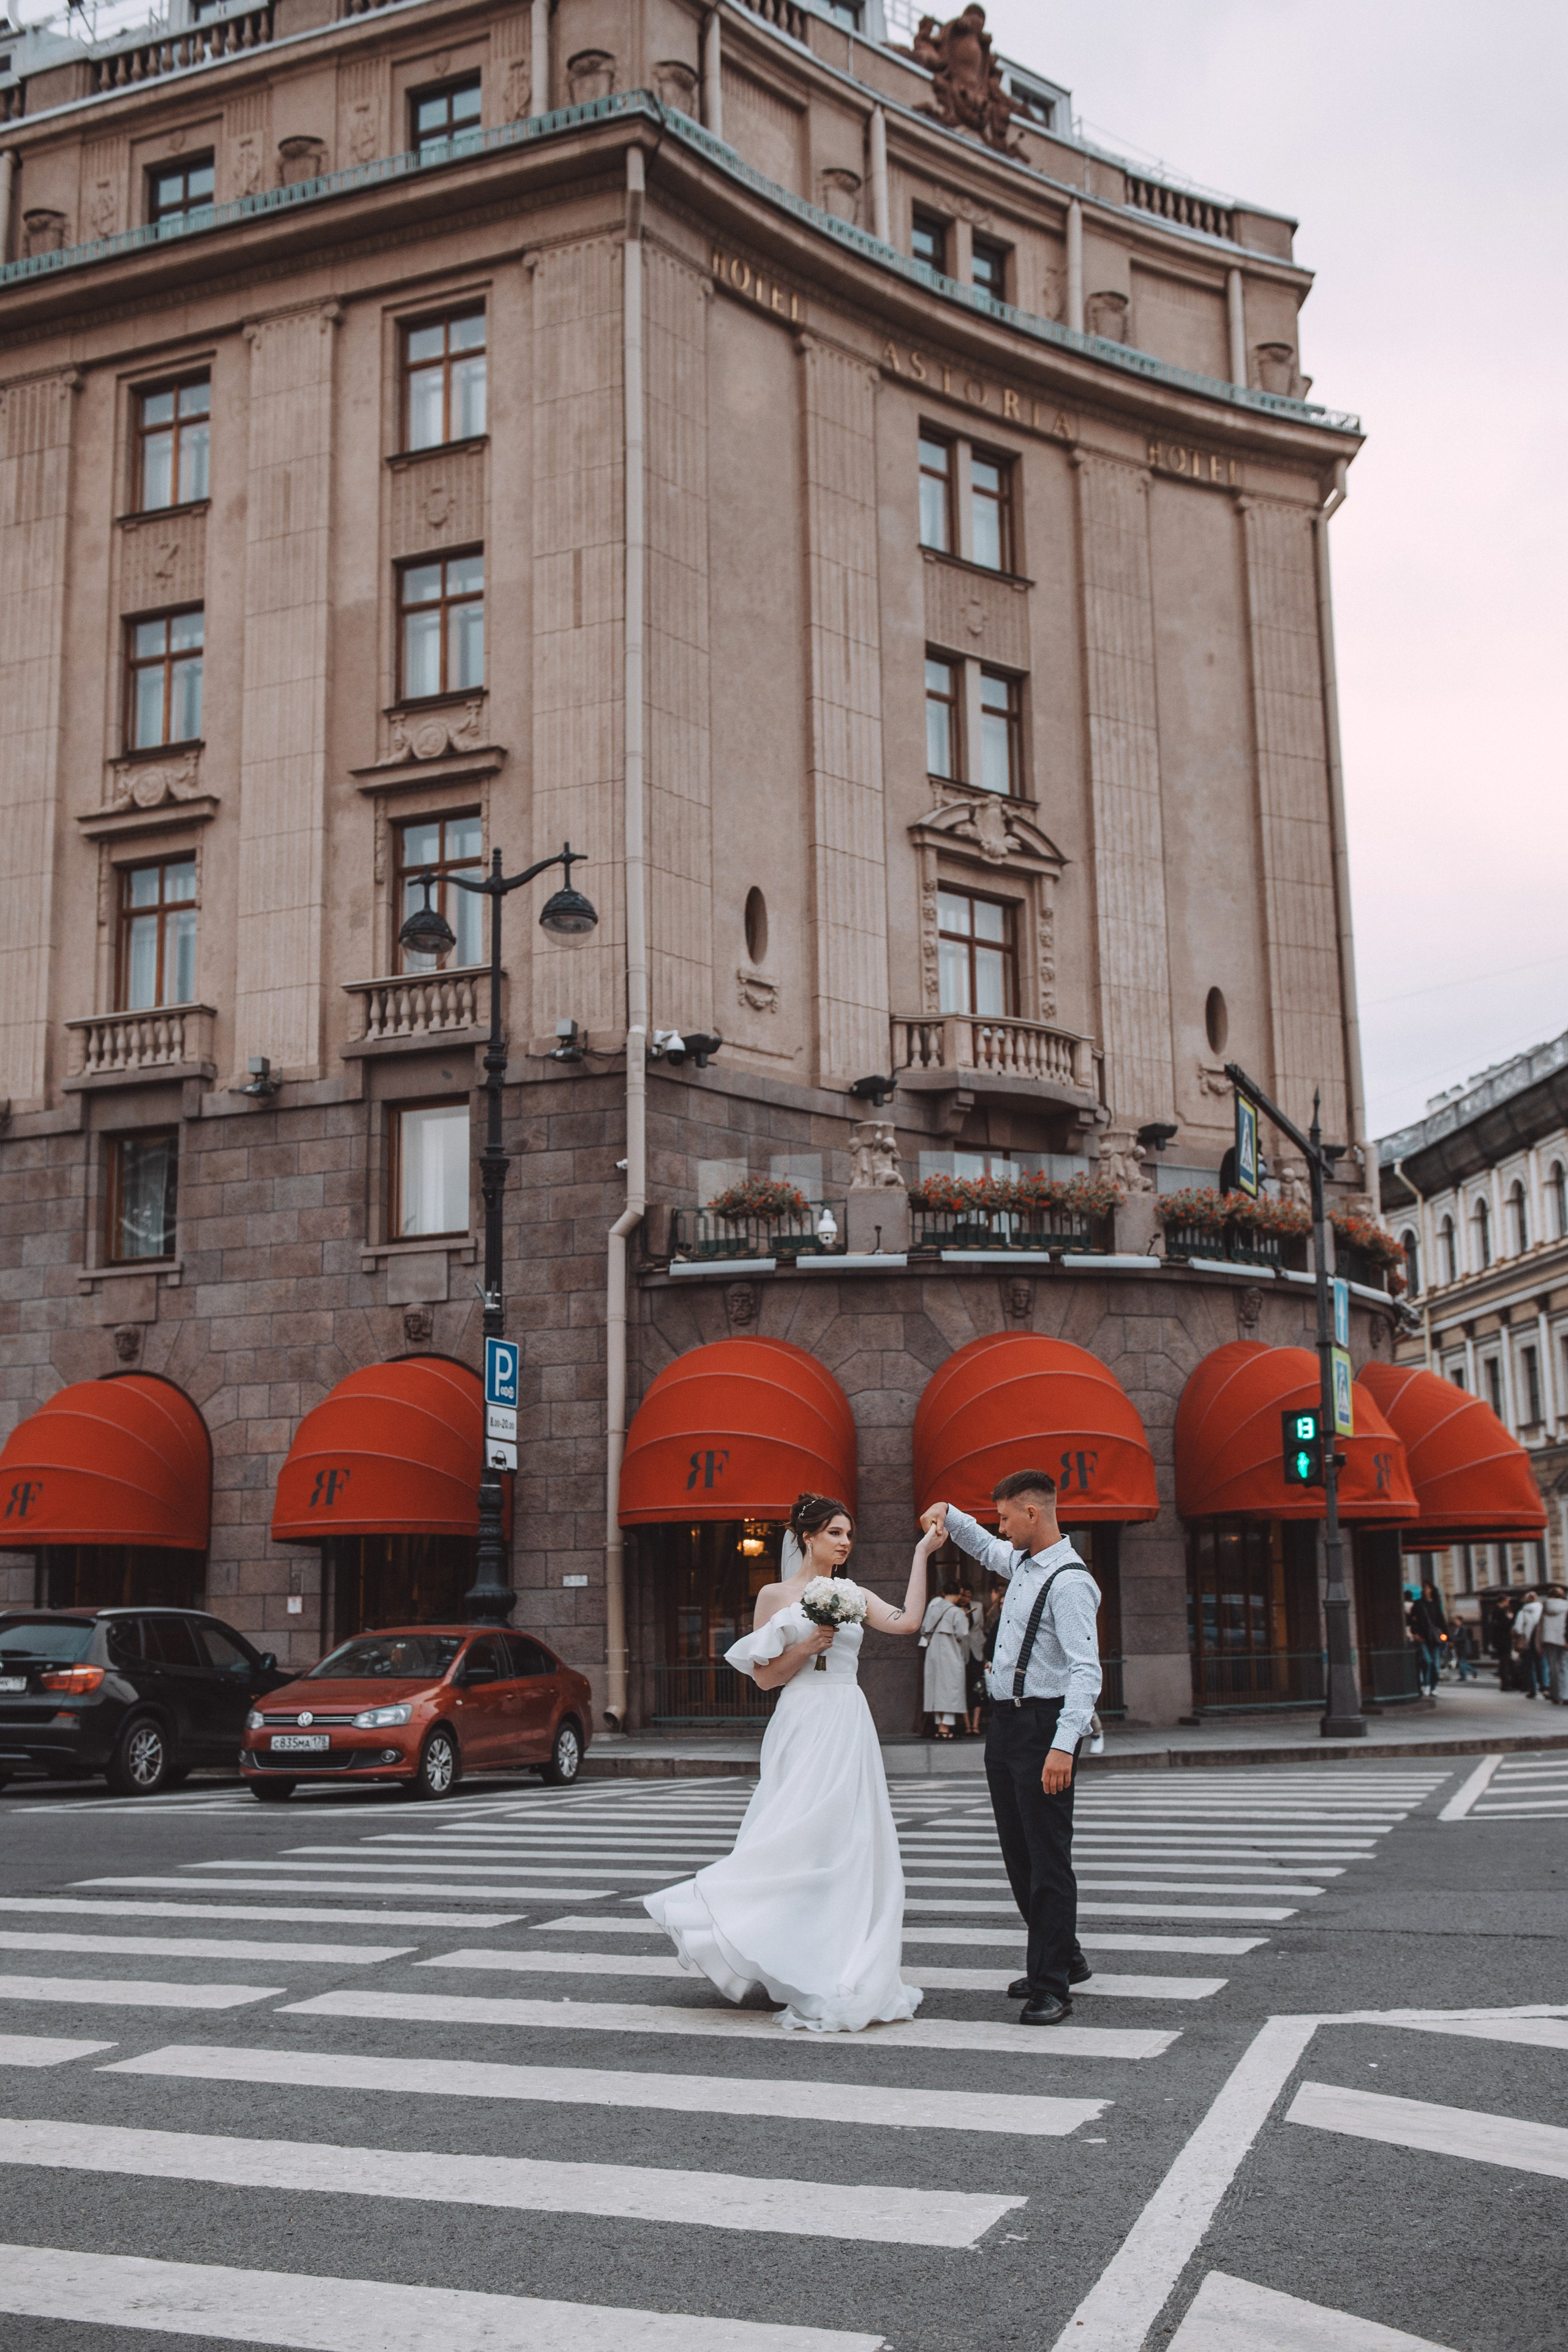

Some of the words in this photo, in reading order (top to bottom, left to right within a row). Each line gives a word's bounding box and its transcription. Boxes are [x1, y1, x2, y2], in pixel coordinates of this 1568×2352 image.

[884, 340, 1074, 440] ASTORIA
[495, 1348, 513, 1397] P
[1297, 1417, 1314, 1439] 13
